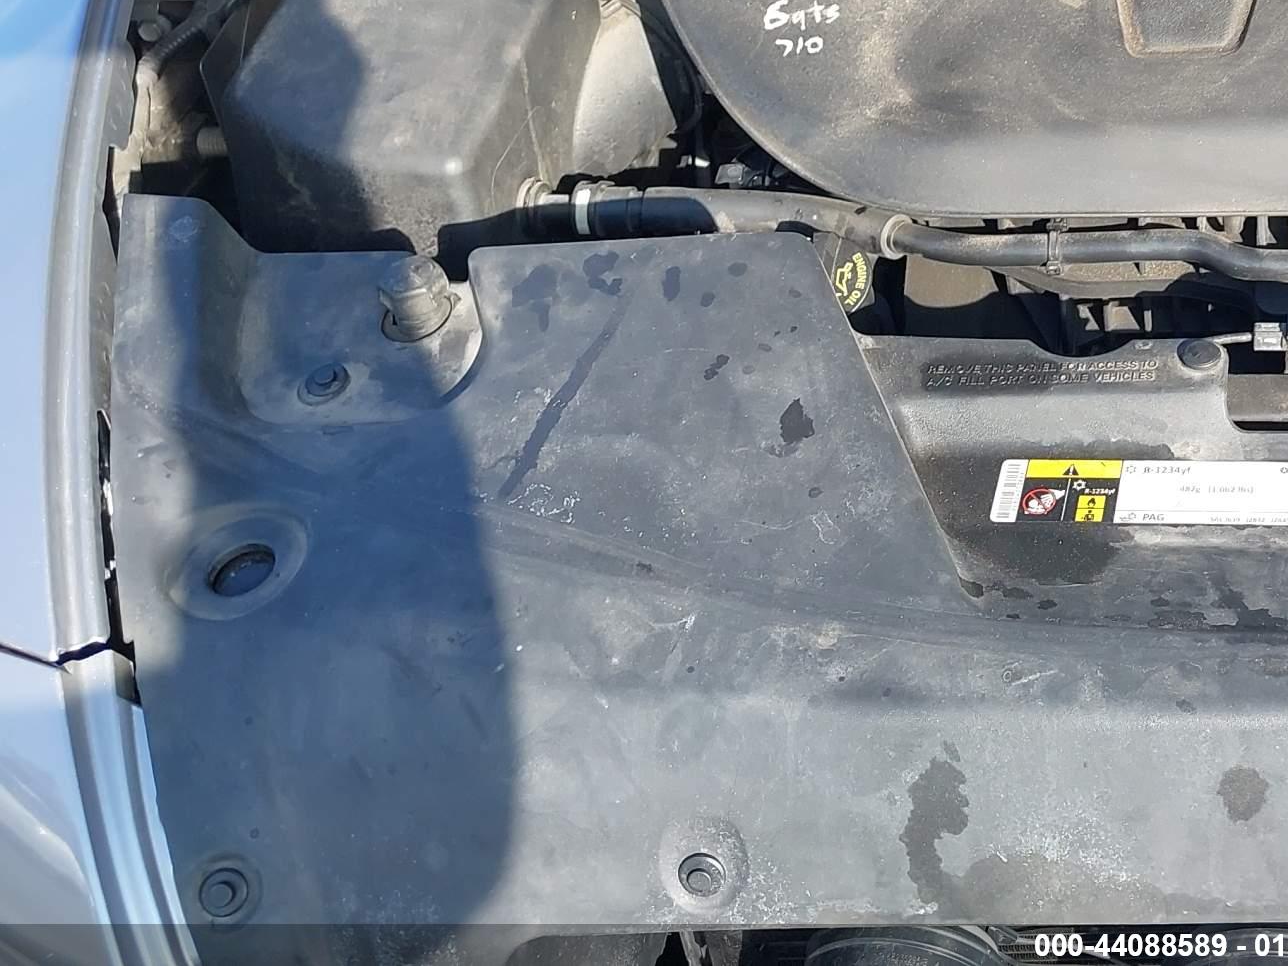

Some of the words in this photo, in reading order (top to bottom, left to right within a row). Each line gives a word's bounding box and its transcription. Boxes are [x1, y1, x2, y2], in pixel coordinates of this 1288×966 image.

[852, 252, 867, 289] ENGINE
[844, 290, 861, 305] OIL
[927, 363, 981, 374] REMOVE
[984, 363, 1013, 374] THIS
[1016, 362, 1057, 373] PANEL
[1060, 362, 1088, 372] FOR
[1089, 361, 1138, 371] ACCESS
[1140, 360, 1158, 370] TO
[926, 376, 953, 387] A/C
[958, 375, 985, 386] FILL
[989, 374, 1023, 386] PORT
[1028, 374, 1048, 385] ON
[1050, 372, 1089, 384] SOME
[1094, 370, 1154, 382] VEHICLES
[1143, 465, 1192, 476] R-1234yf
[1142, 512, 1165, 522] PAG
